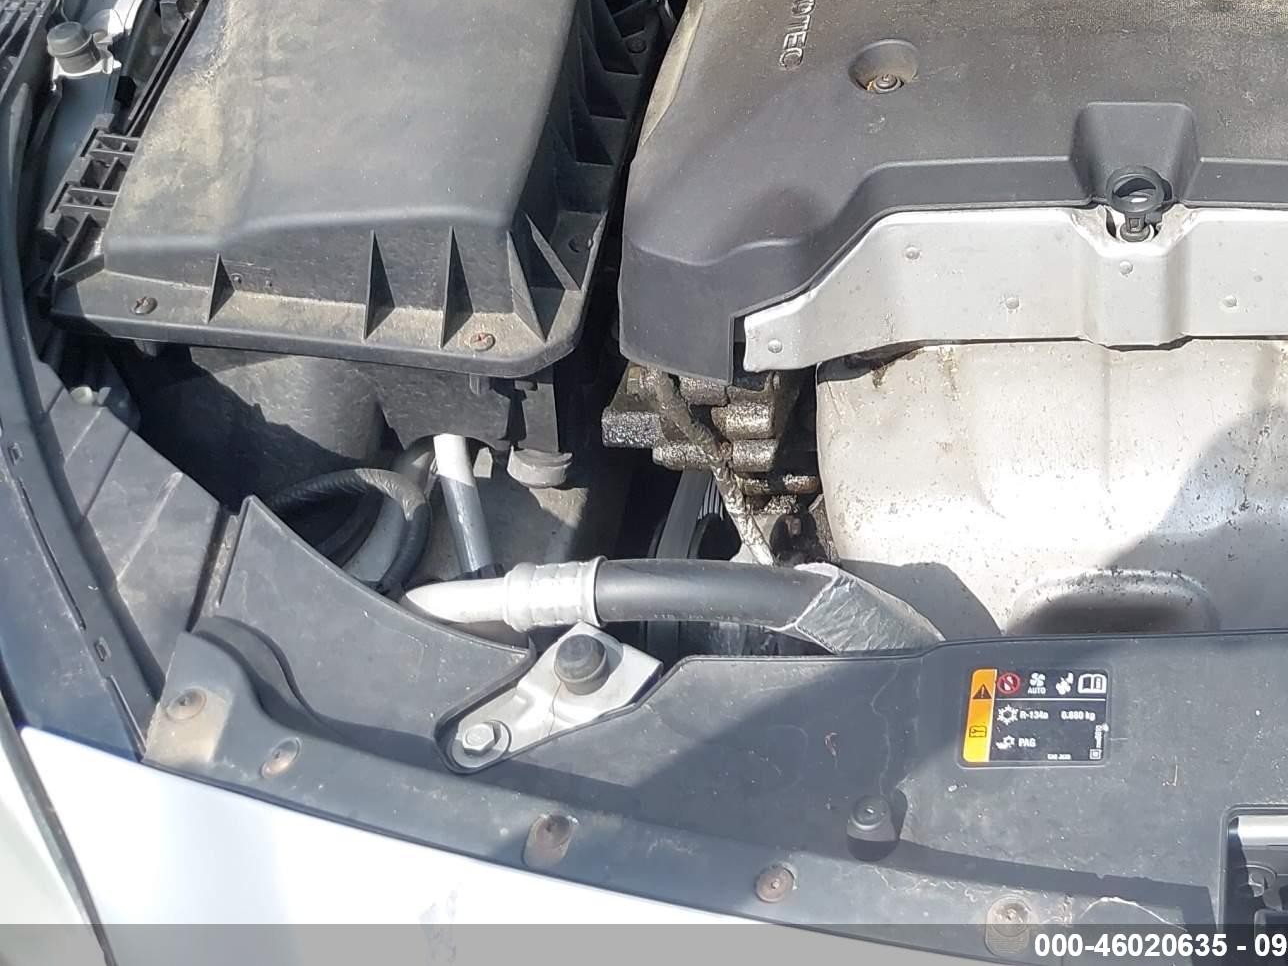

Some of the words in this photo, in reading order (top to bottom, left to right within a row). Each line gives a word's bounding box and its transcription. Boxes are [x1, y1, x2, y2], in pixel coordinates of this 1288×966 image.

[1027, 686, 1047, 695] AUTO
[1019, 710, 1049, 720] R-134a
[1085, 710, 1096, 722] kg
[1018, 737, 1036, 747] PAG
